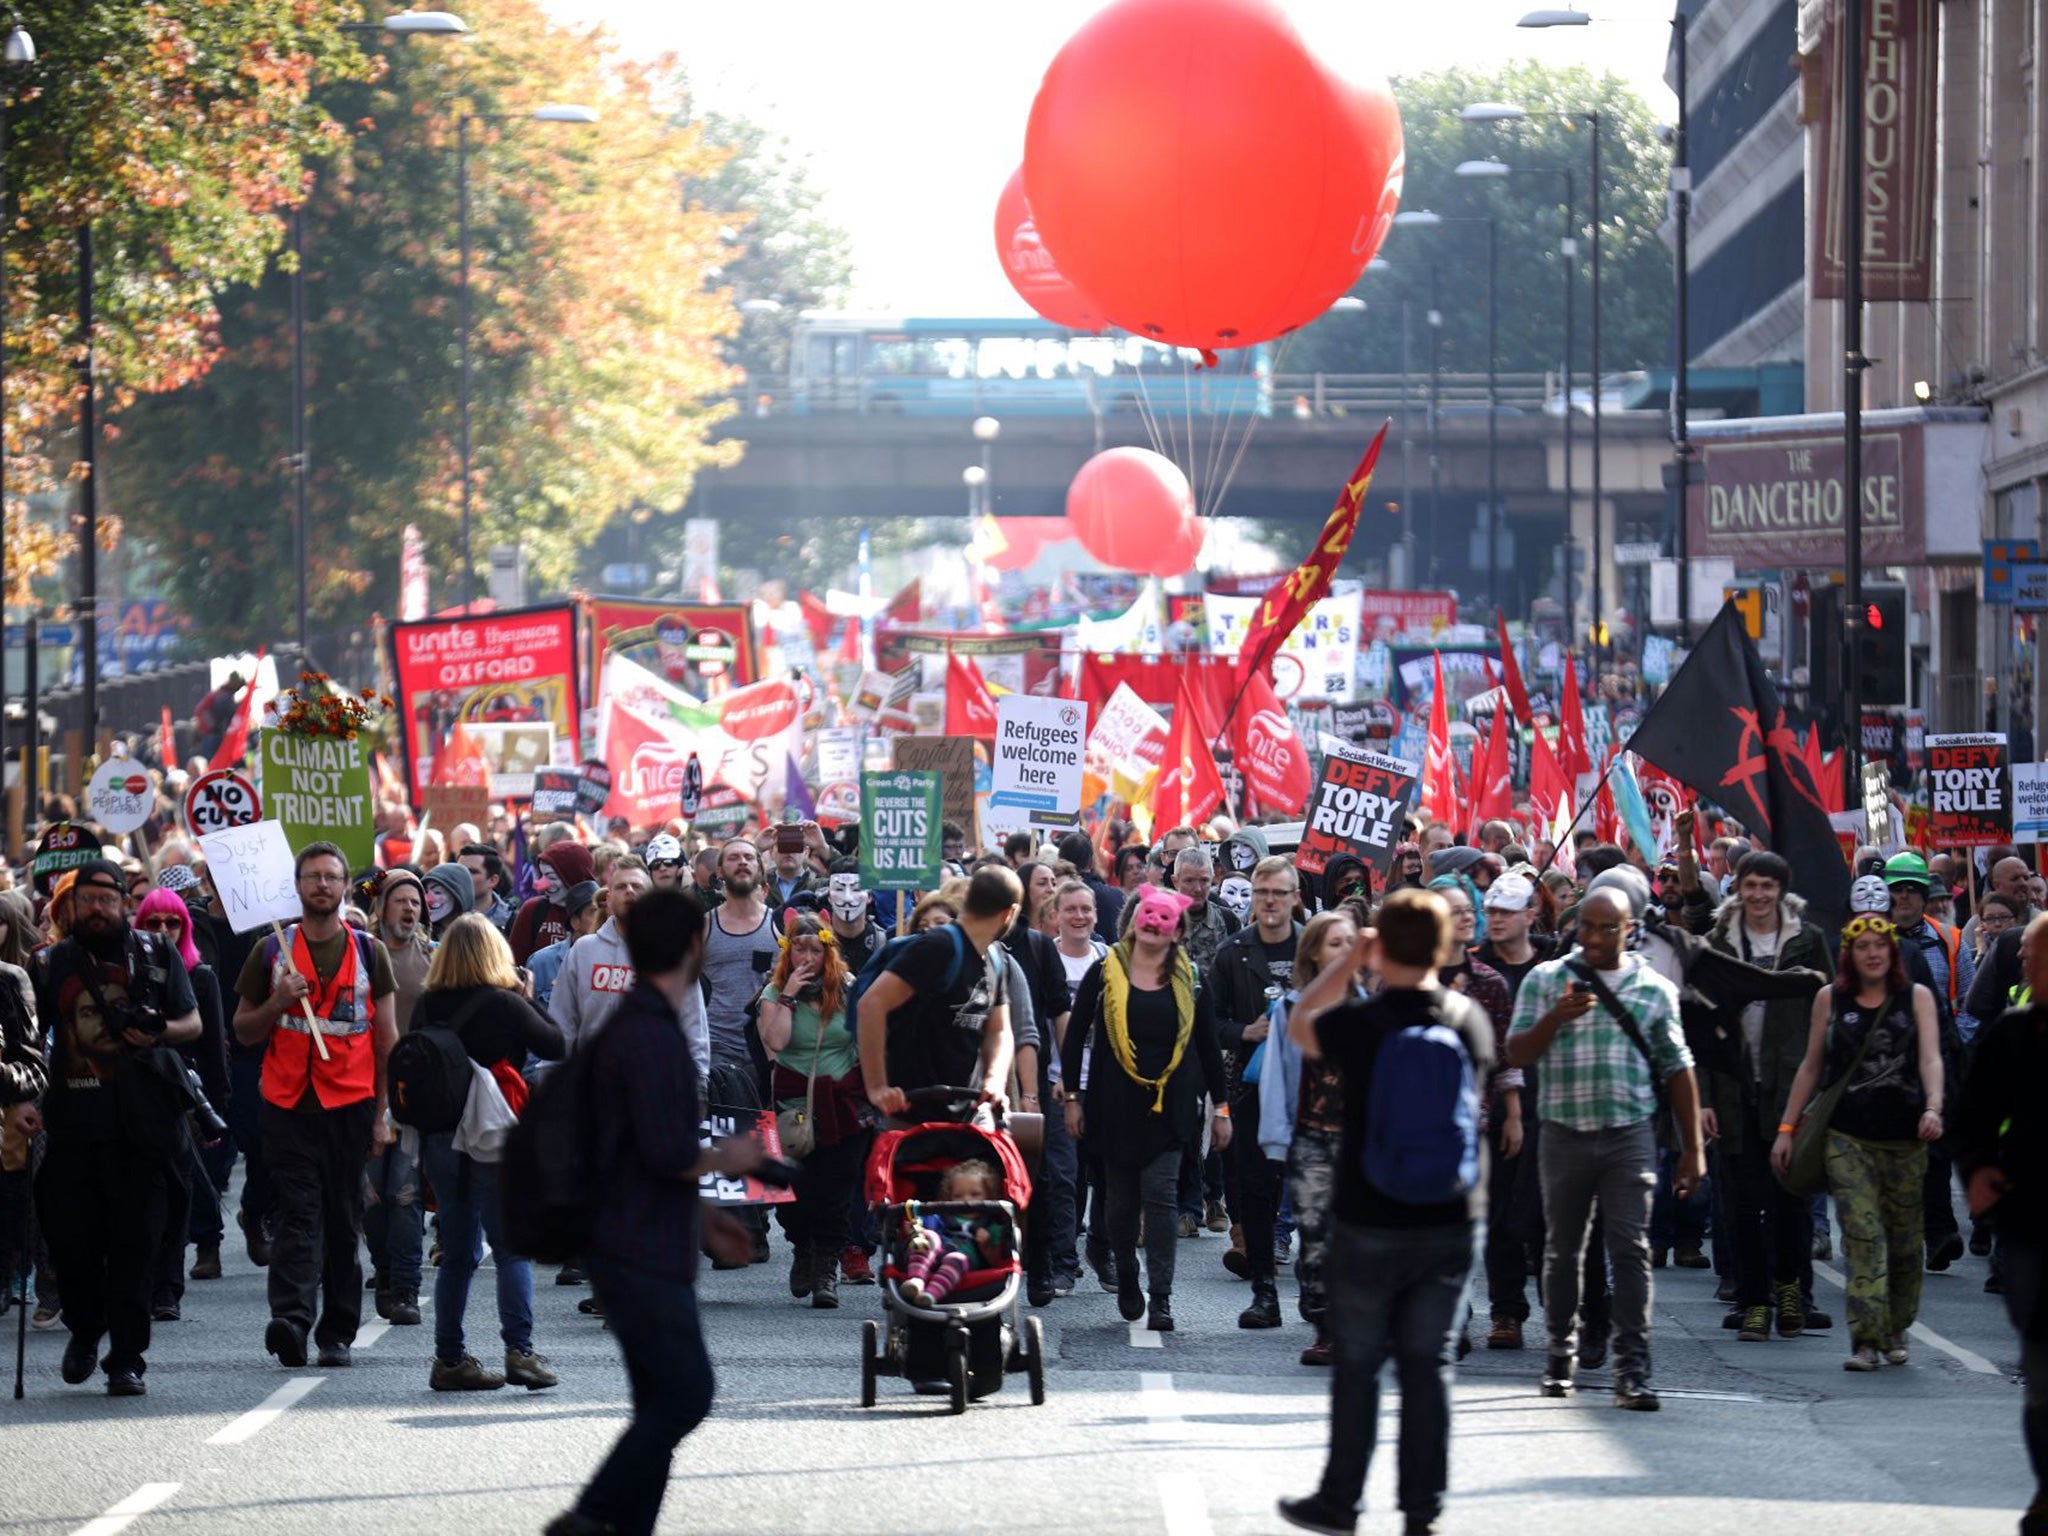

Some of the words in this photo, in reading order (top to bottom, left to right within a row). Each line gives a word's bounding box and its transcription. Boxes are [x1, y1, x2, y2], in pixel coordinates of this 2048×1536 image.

[1787, 450, 1812, 473] THE
[1710, 475, 1898, 528] DANCEHOSE
[409, 624, 477, 651] unite
[440, 655, 535, 684] OXFORD
[1324, 678, 1346, 692] 22
[1004, 720, 1078, 747] Refugees
[1935, 737, 1968, 746] Socialist
[1968, 735, 1997, 745] Worker
[270, 735, 361, 769] CLIMATE
[1002, 743, 1077, 766] welcome
[1338, 747, 1376, 764] Socialist
[1376, 758, 1407, 774] Worker
[1931, 747, 1999, 769] DEFY
[292, 769, 343, 794] NOT
[866, 778, 892, 787] Green
[912, 780, 935, 790] Party
[1019, 764, 1056, 785] here
[1325, 758, 1407, 799] DEFY
[1931, 767, 2001, 790] TORY
[205, 785, 243, 804] NO
[874, 797, 909, 808] REVERSE
[911, 797, 927, 808] THE
[1321, 782, 1401, 823] TORY
[1933, 789, 2002, 812] RULE
[193, 807, 252, 826] CUTS
[272, 793, 363, 827] TRIDENT
[873, 810, 928, 837] CUTS
[1311, 806, 1393, 848] RULE
[206, 833, 267, 864] Just
[873, 848, 895, 869] US
[897, 848, 928, 869] ALL
[238, 862, 257, 875] Be
[231, 878, 297, 912] NICE
